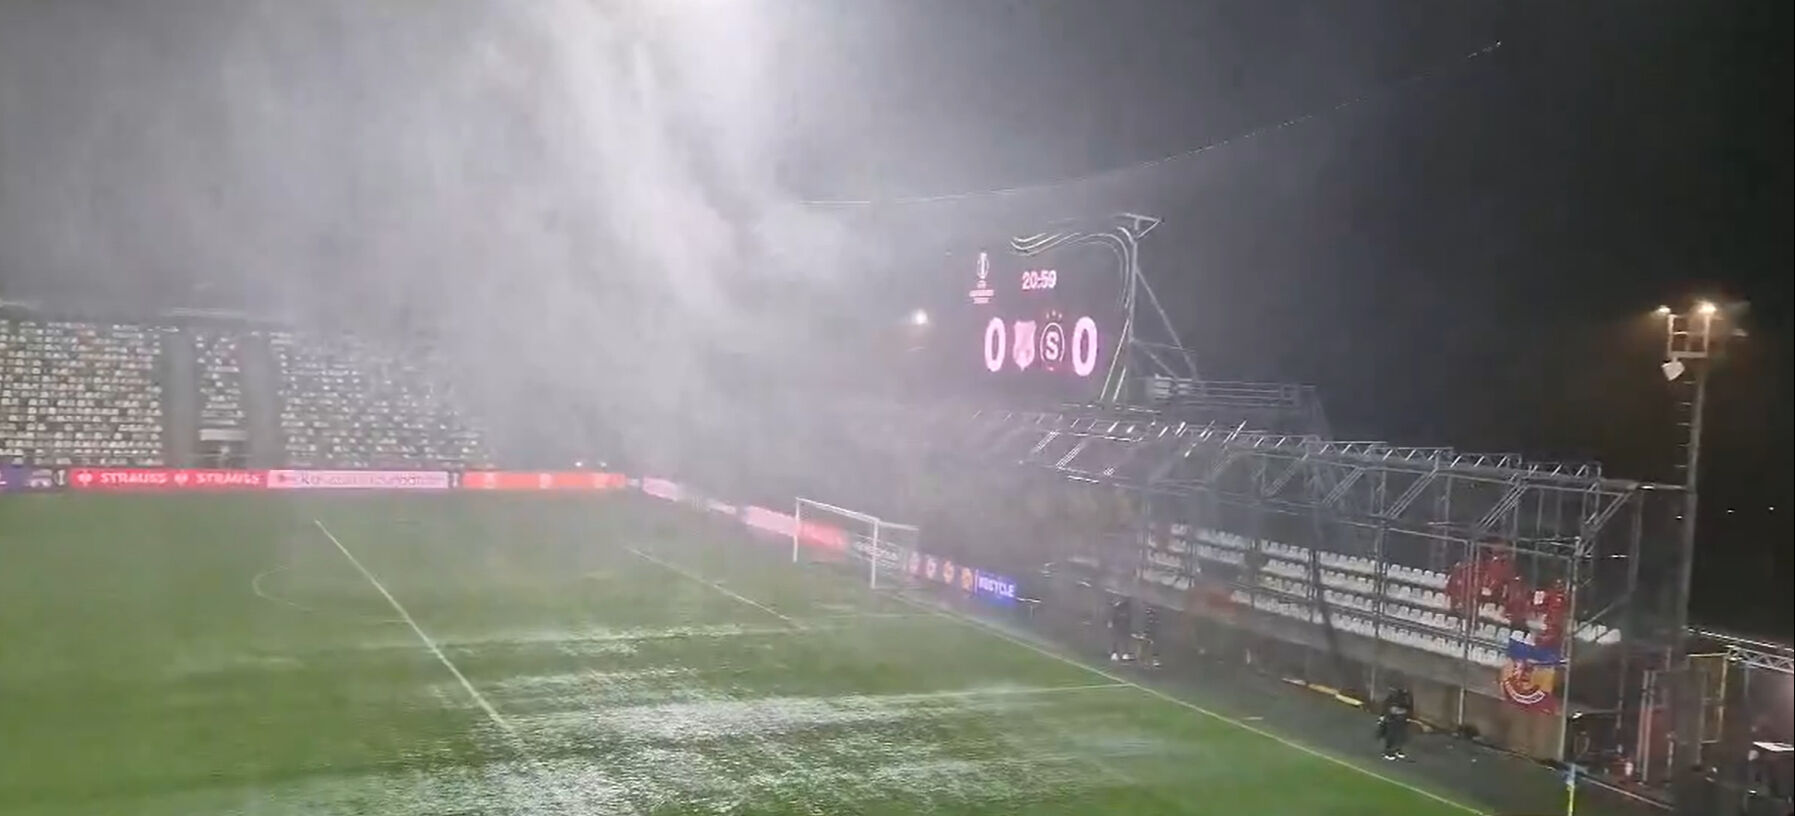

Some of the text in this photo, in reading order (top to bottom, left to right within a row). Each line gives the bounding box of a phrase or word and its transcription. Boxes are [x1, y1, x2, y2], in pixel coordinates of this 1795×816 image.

[1021, 269, 1057, 290] 20:59
[984, 316, 1097, 377] 0 S 0
[100, 472, 260, 485] STRAUSS STRAUSS
